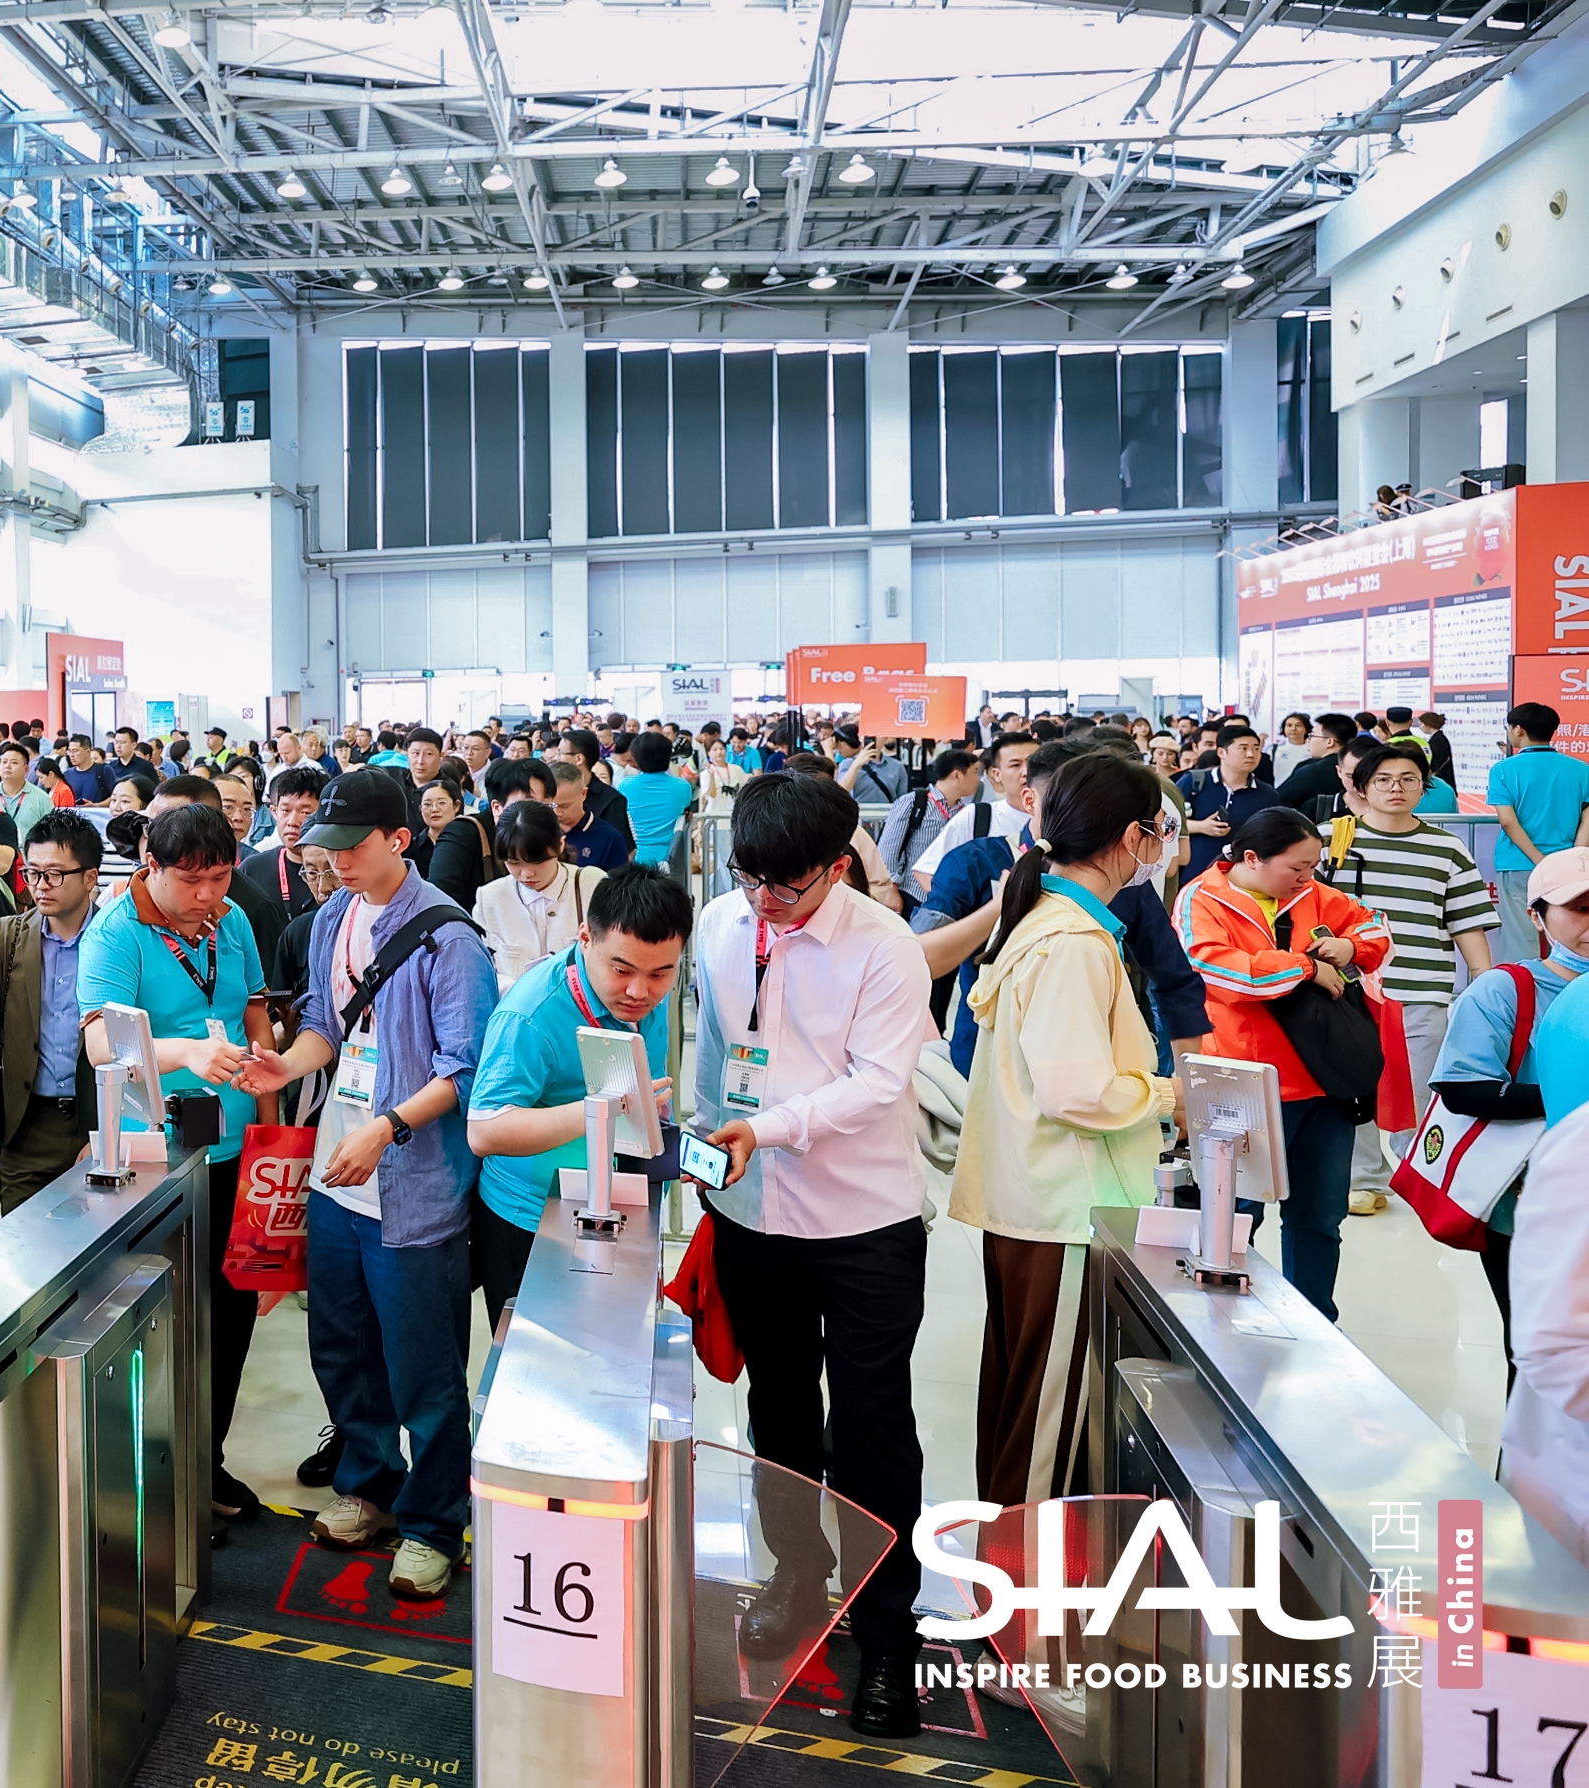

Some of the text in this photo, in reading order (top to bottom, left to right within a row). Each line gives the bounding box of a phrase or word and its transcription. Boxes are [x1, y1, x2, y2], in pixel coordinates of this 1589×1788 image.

[1554, 555, 1589, 639] SIAL
[65, 654, 91, 683] SIAL
[672, 678, 709, 691] SIAL
[810, 667, 856, 683] Free
[255, 1163, 311, 1199] SIA
[270, 1202, 308, 1231] 西
[513, 1552, 595, 1623] 16
[206, 1711, 460, 1775] please do not stay
[1471, 1707, 1588, 1788] 17
